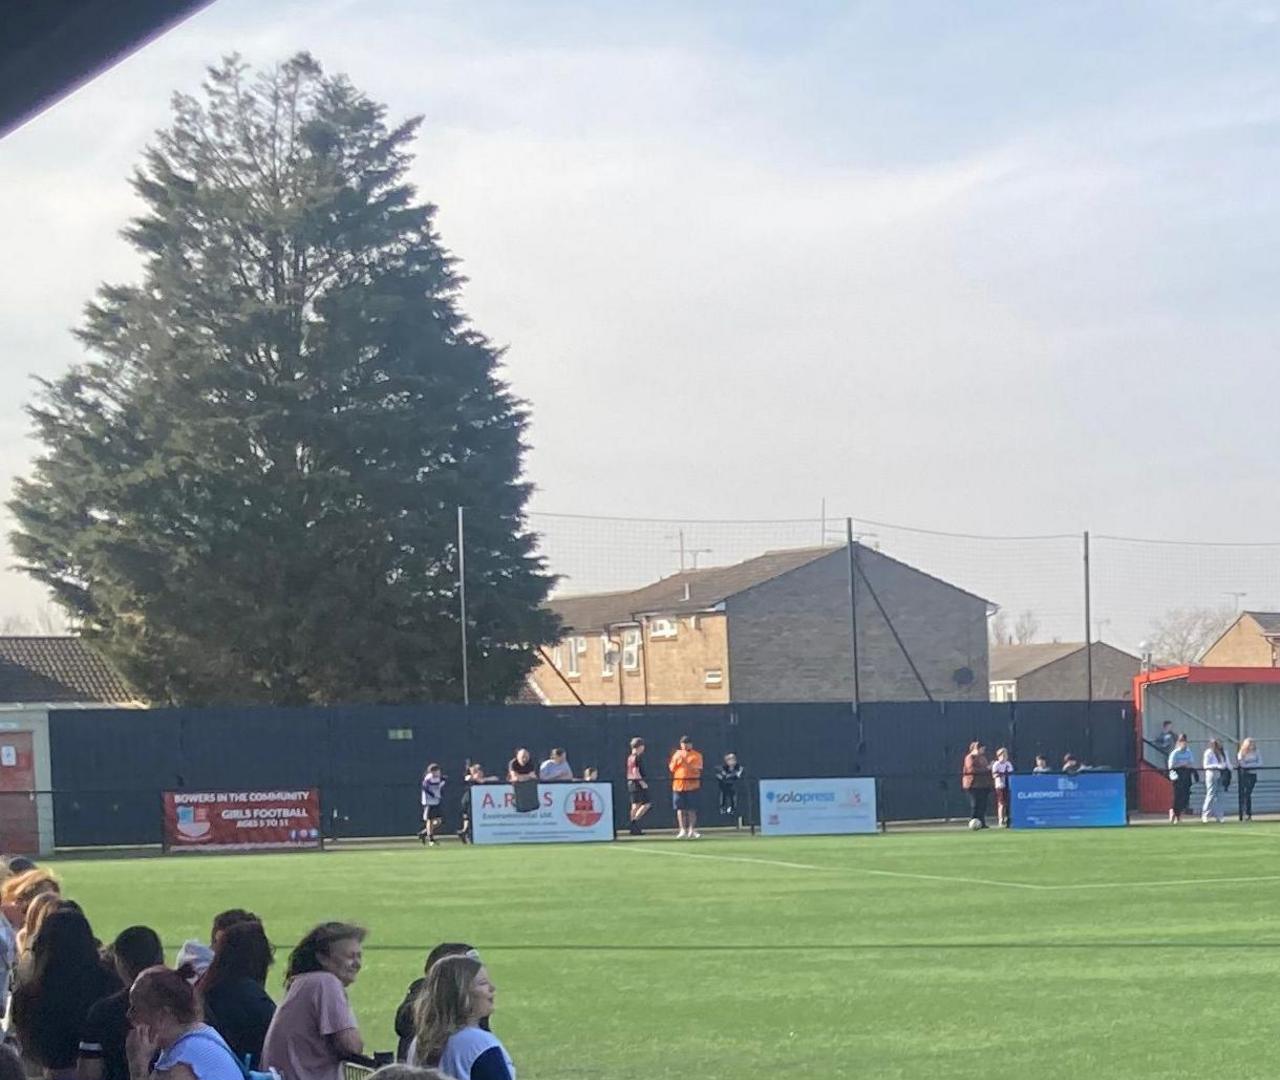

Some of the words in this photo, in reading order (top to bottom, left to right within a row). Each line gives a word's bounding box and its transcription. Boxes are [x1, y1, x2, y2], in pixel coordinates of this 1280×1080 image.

[174, 794, 215, 803] BOWERS
[216, 794, 227, 802] IN
[230, 793, 247, 802] THE
[249, 791, 310, 801] COMMUNITY
[776, 791, 834, 804] solopress
[221, 809, 251, 819] GIRLS
[253, 807, 308, 818] FOOTBALL
